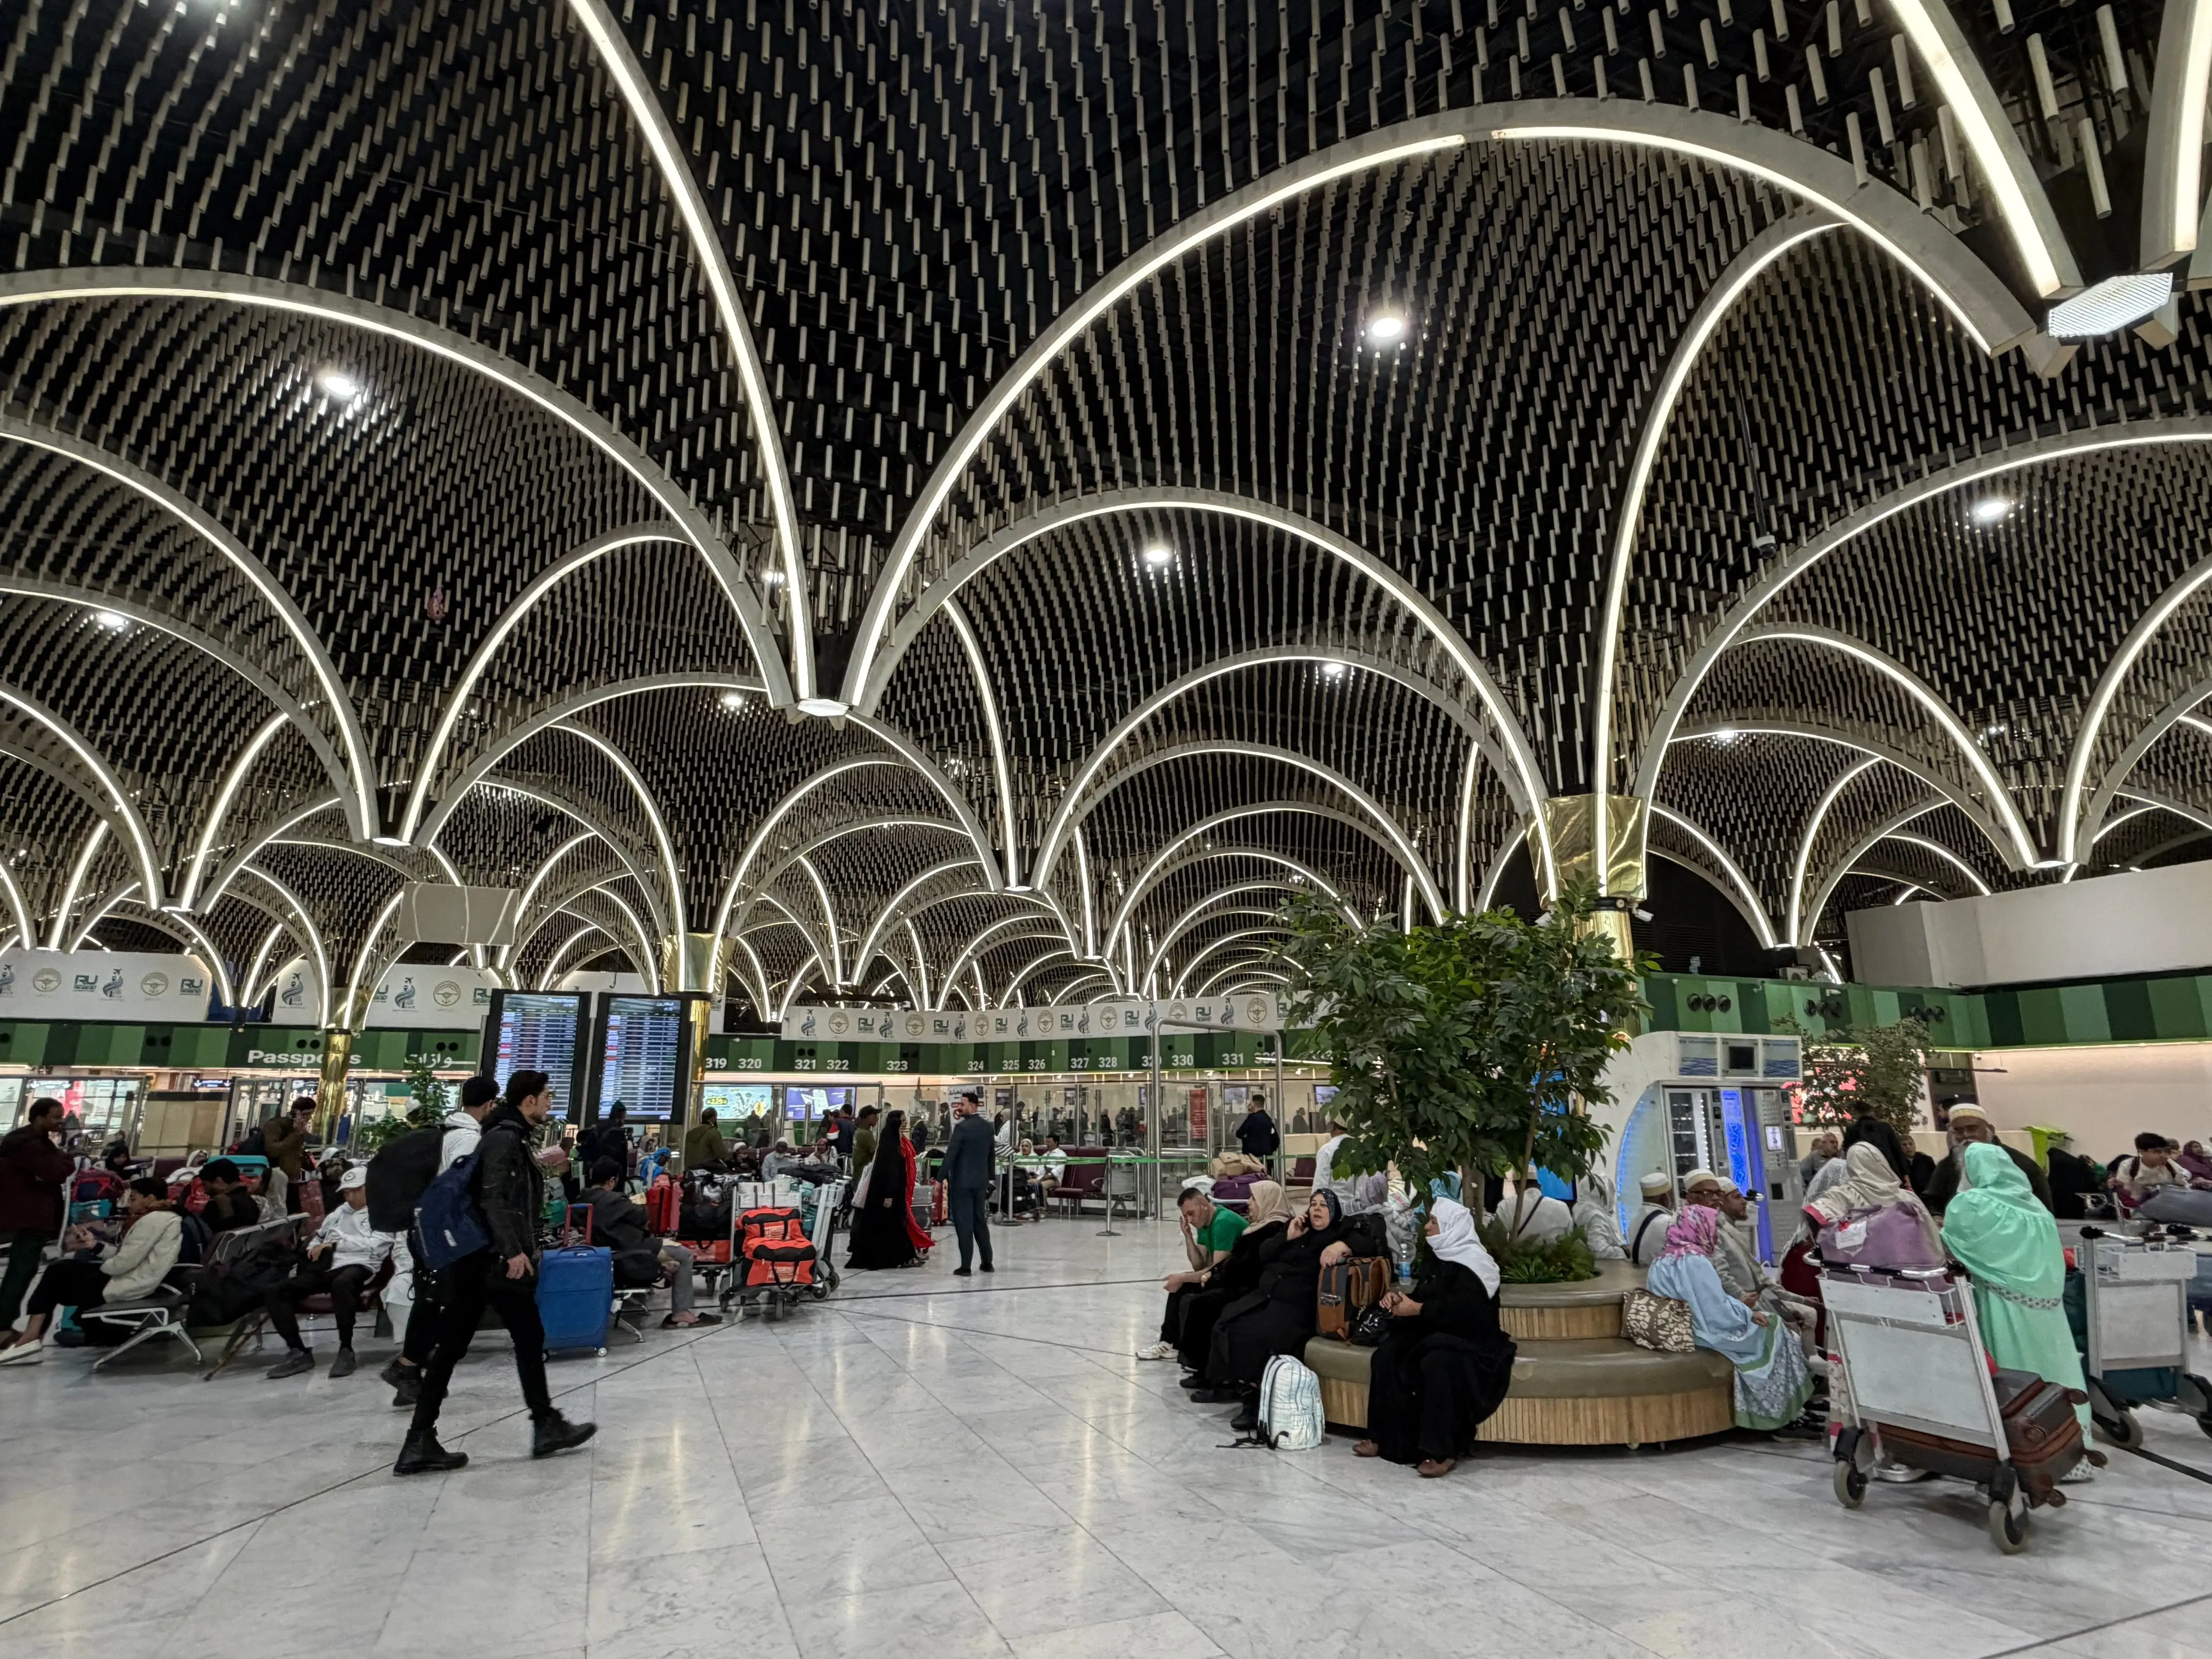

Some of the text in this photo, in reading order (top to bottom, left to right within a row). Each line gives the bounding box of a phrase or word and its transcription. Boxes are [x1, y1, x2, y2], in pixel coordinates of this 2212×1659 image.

[247, 1050, 361, 1067] Passps
[706, 1057, 727, 1069] 319
[738, 1058, 762, 1069] 320
[1070, 1057, 1089, 1068] 327
[1098, 1056, 1117, 1068] 328
[1172, 1054, 1194, 1066] 330
[1222, 1053, 1243, 1065] 331
[794, 1059, 816, 1070] 321
[826, 1059, 849, 1070] 322
[887, 1060, 908, 1071] 323
[968, 1061, 984, 1071] 324
[1002, 1060, 1020, 1070] 325
[1028, 1059, 1046, 1070] 326
